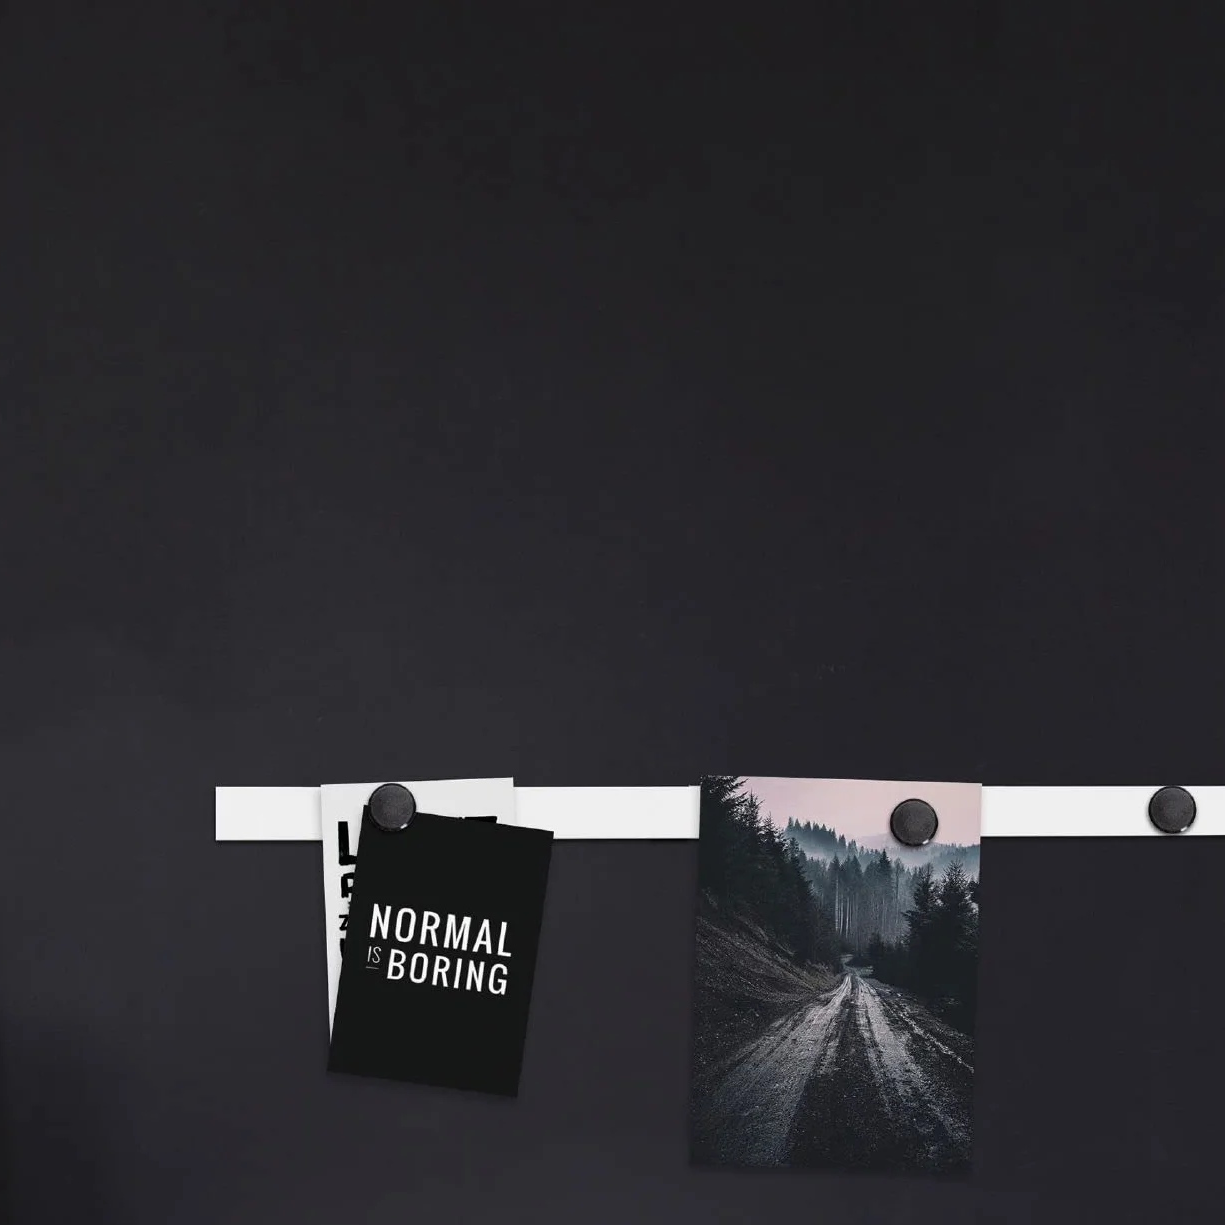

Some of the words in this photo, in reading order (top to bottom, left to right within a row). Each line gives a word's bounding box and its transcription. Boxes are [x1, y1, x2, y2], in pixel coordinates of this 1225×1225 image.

[369, 903, 513, 958] NORMAL
[367, 945, 383, 964] IS
[386, 948, 509, 996] BORING
